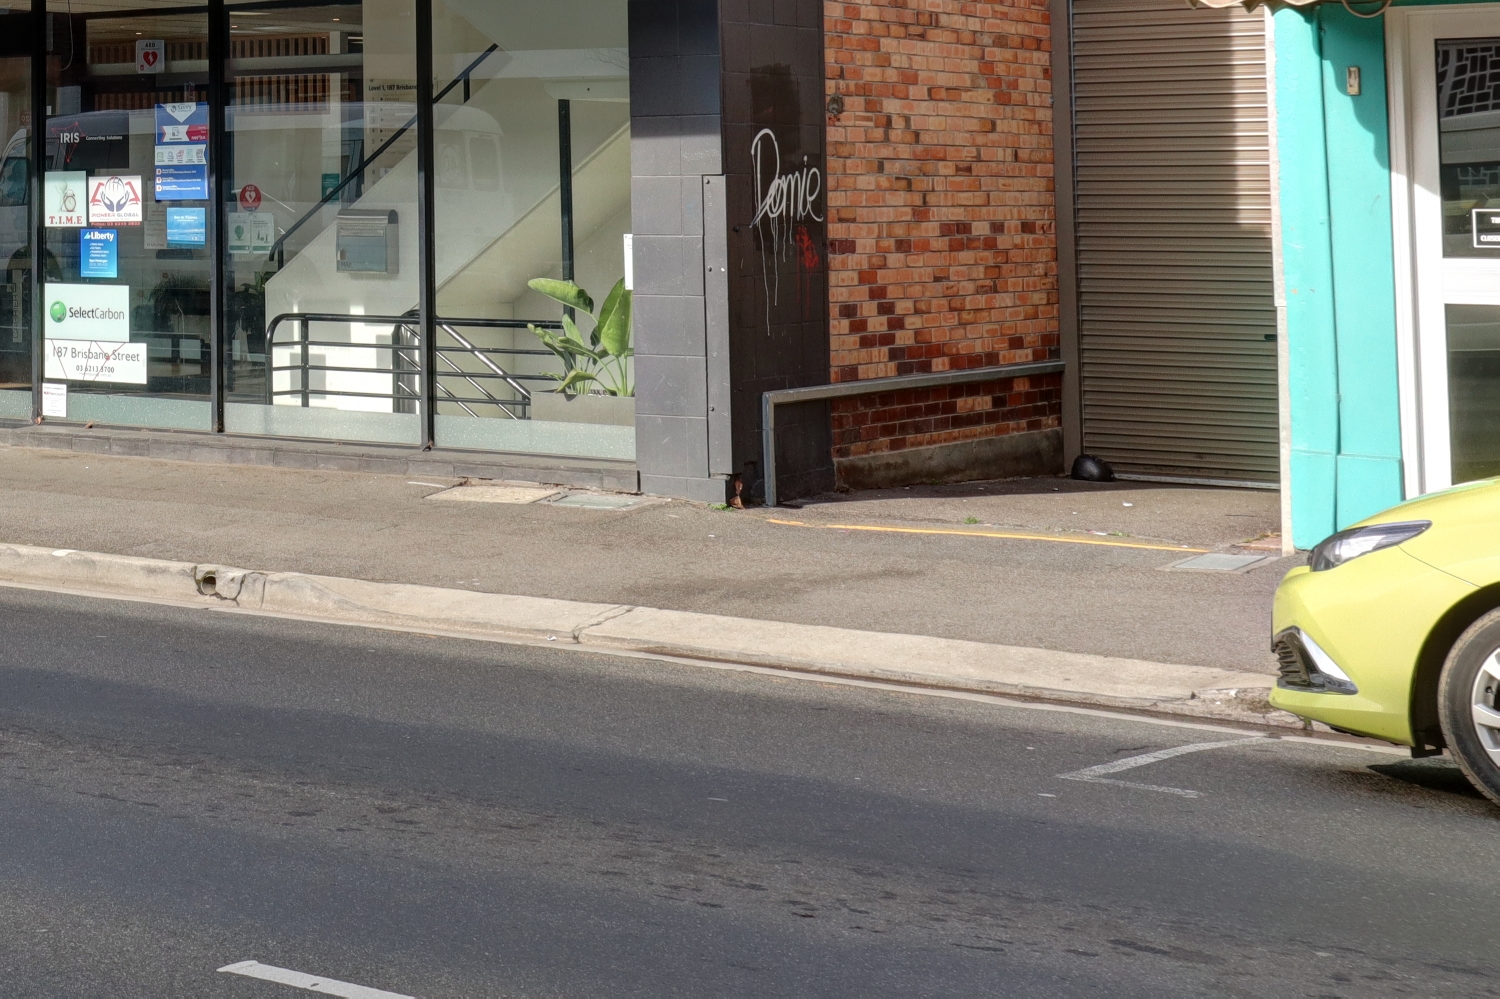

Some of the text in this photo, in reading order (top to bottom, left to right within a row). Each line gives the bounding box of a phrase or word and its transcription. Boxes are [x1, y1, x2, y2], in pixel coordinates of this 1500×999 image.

[60, 133, 80, 143] IRIS
[91, 231, 114, 241] Liberty
[69, 307, 125, 320] SelectCarbon
[52, 346, 140, 362] 187 Brisbane Street
